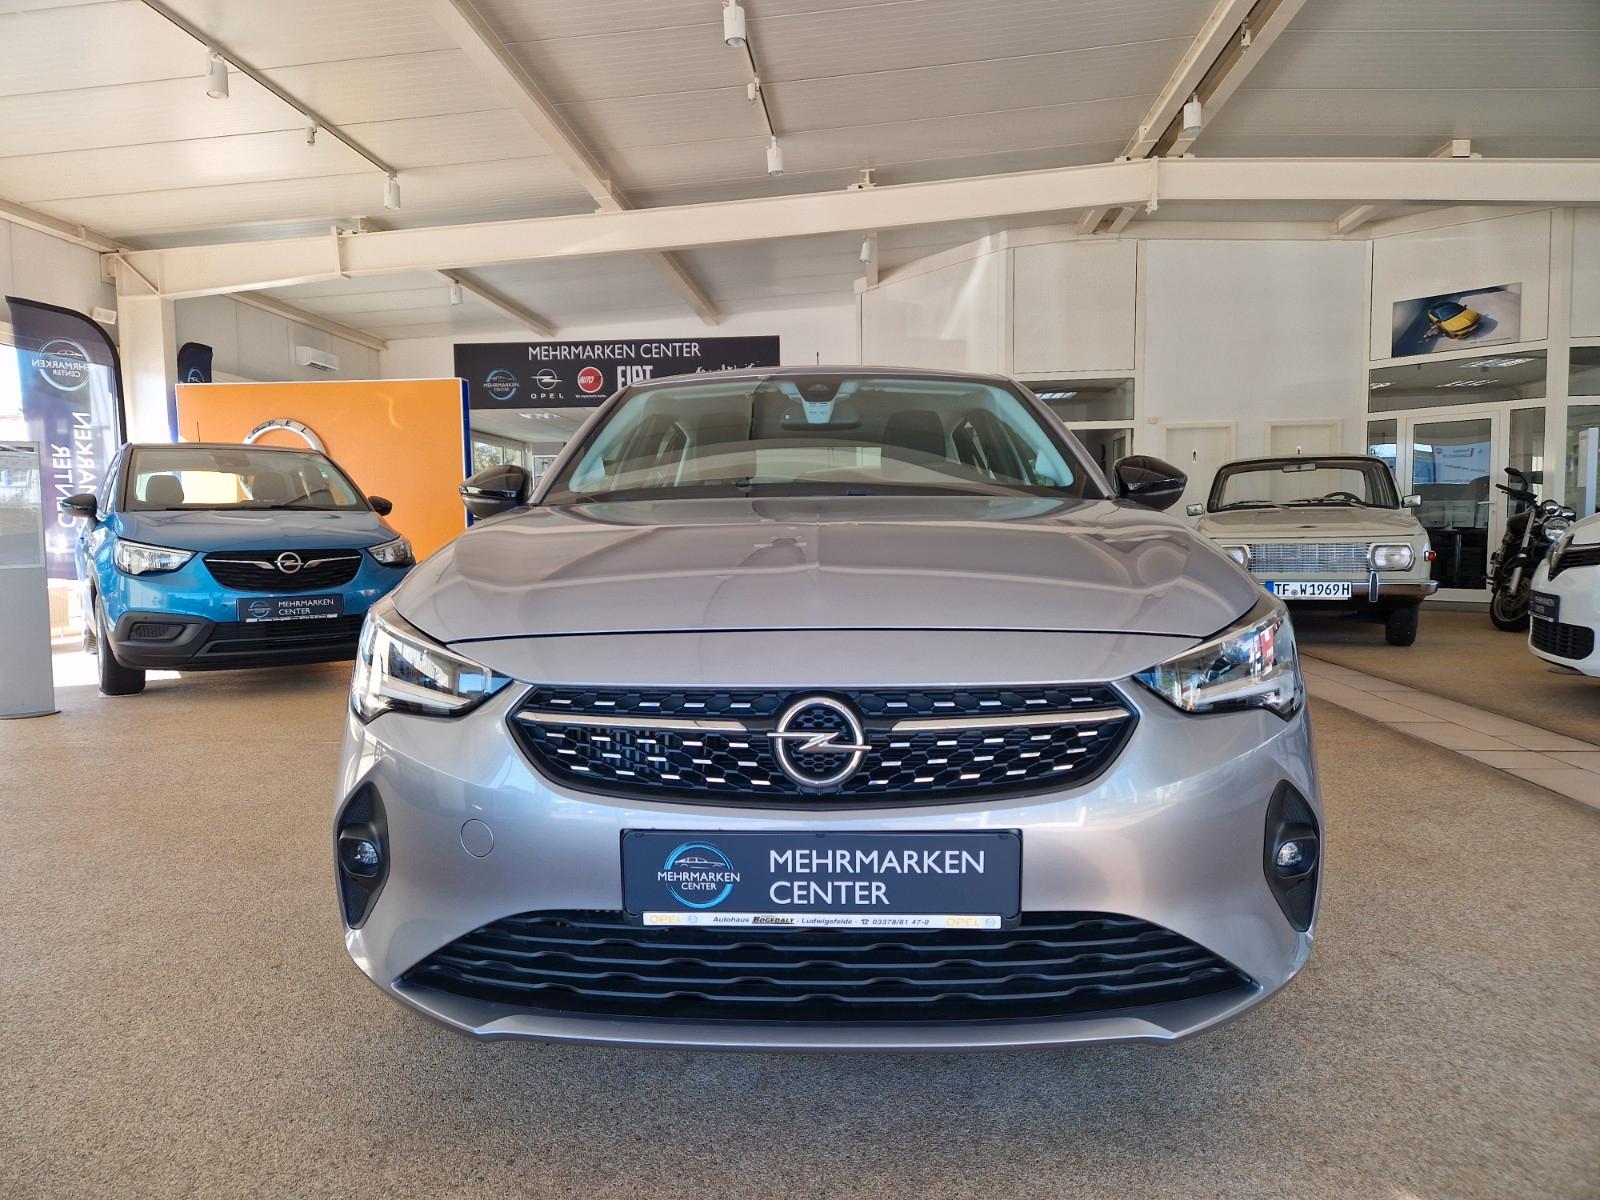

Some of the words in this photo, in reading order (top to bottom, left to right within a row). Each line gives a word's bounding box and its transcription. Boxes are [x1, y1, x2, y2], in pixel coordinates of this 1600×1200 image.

[528, 344, 635, 361] MEHRMARKEN
[640, 342, 702, 358] CENTER
[617, 365, 654, 391] FIAT
[1275, 583, 1290, 596] TF
[1300, 583, 1350, 596] W1969H
[278, 599, 334, 608] MEHRMARKEN
[278, 608, 311, 616] CENTER
[769, 849, 985, 874] MEHRMARKEN
[657, 871, 741, 883] MEHRMARKEN
[681, 882, 717, 891] CENTER
[769, 881, 890, 905] CENTER
[713, 916, 750, 924] Autohaus
[801, 917, 853, 926] Ludwigsfelde
